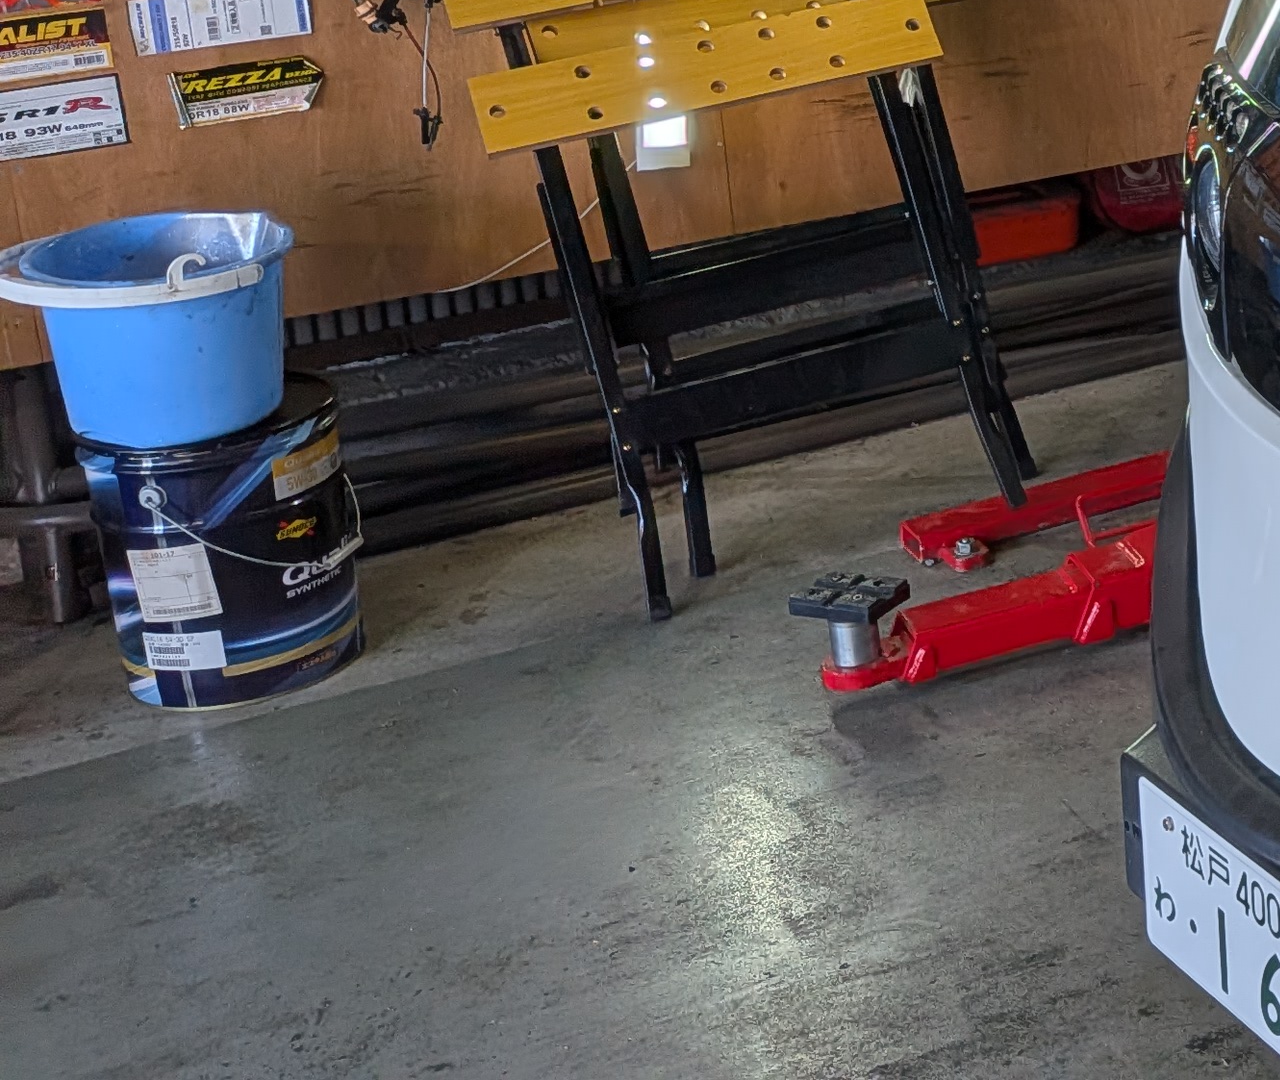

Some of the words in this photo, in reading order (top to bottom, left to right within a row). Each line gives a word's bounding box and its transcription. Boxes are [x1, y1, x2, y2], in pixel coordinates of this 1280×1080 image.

[223, 103, 250, 114] 88W
[24, 123, 63, 137] 93W
[286, 565, 342, 599] SYNTHETIC
[1180, 824, 1230, 886] 松戸
[1153, 875, 1176, 922] わ
